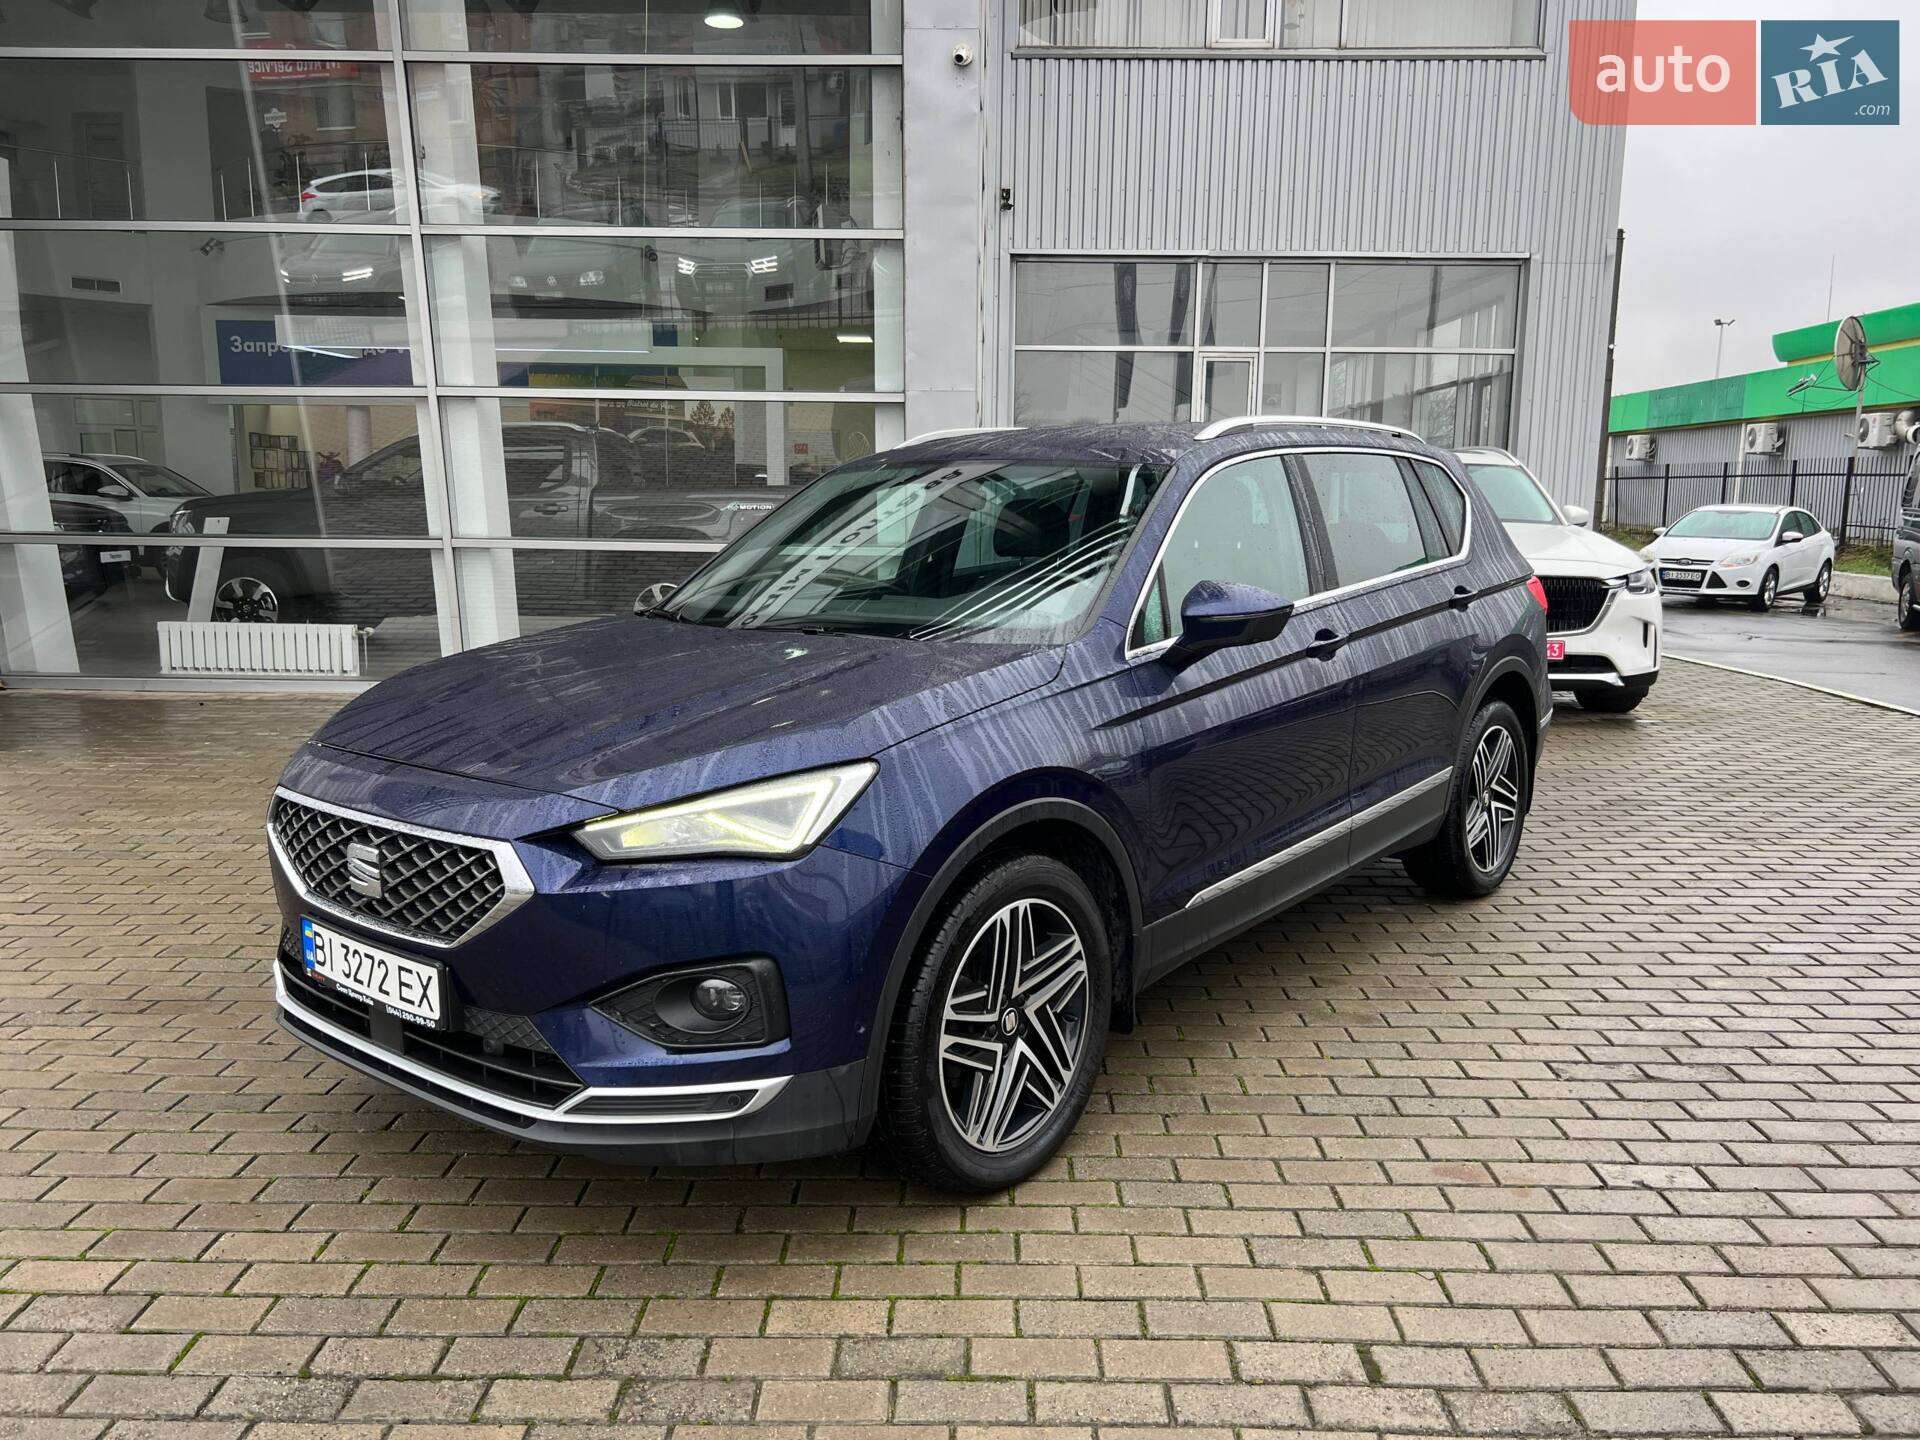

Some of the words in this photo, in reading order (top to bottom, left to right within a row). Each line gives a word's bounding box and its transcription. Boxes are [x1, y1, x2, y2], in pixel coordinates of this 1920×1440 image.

[313, 930, 334, 972] BI
[340, 942, 390, 997] 3272
[397, 964, 434, 1013] EX
